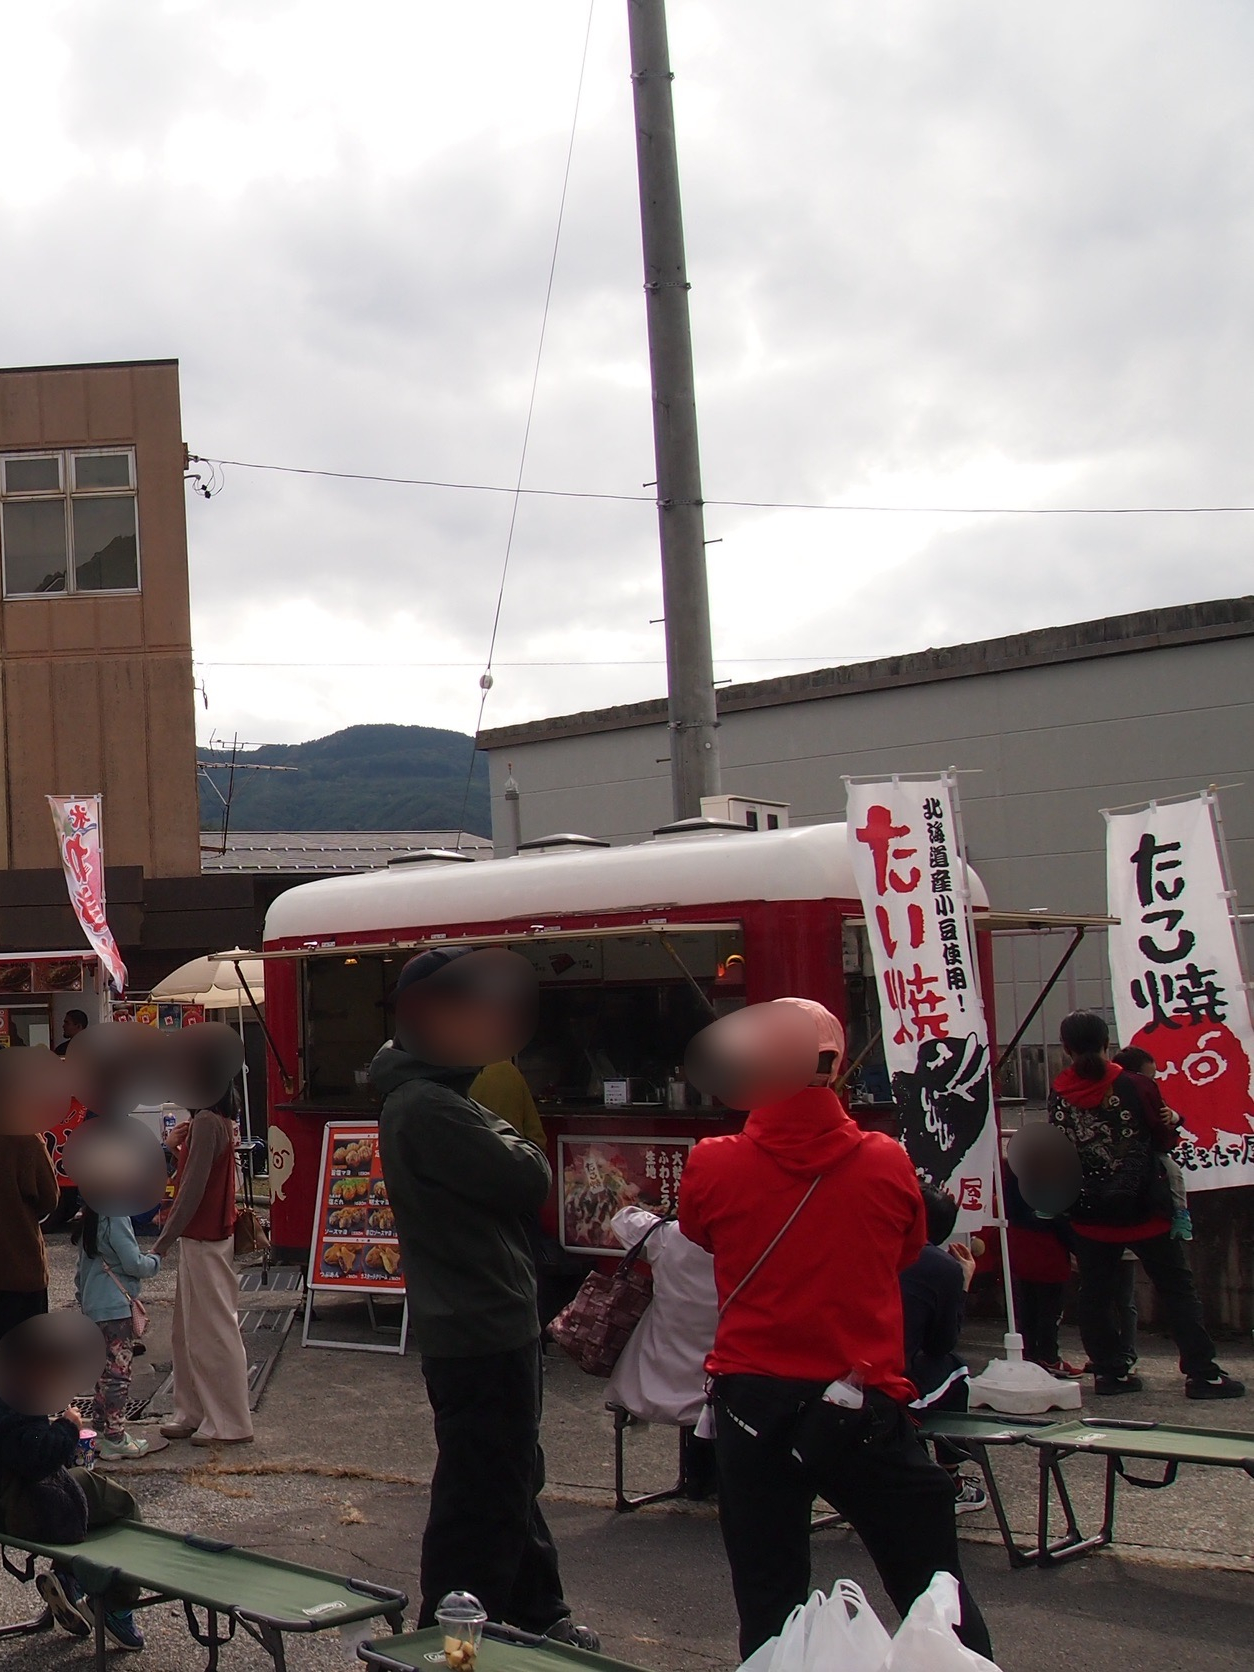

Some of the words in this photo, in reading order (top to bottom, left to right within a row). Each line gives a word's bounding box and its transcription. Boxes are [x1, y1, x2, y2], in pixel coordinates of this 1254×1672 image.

[855, 804, 950, 1046] たい焼
[1130, 833, 1229, 1033] たこ焼
[645, 1150, 657, 1180] 生地
[658, 1151, 671, 1208] ふわとろ
